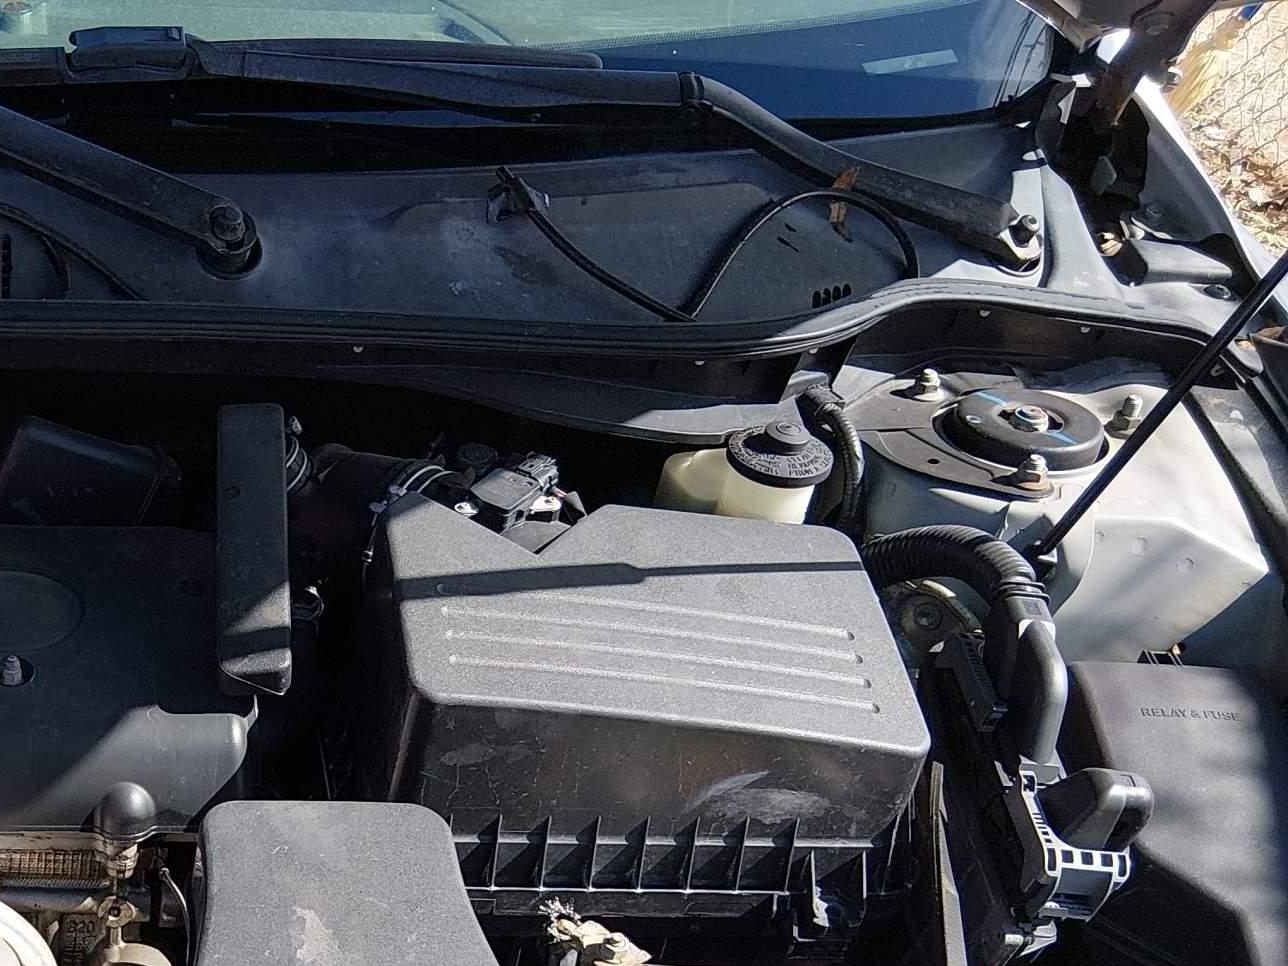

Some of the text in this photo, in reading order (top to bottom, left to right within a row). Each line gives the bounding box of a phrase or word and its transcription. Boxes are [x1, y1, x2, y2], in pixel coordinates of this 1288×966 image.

[1140, 707, 1241, 721] RELAY & FUSE
